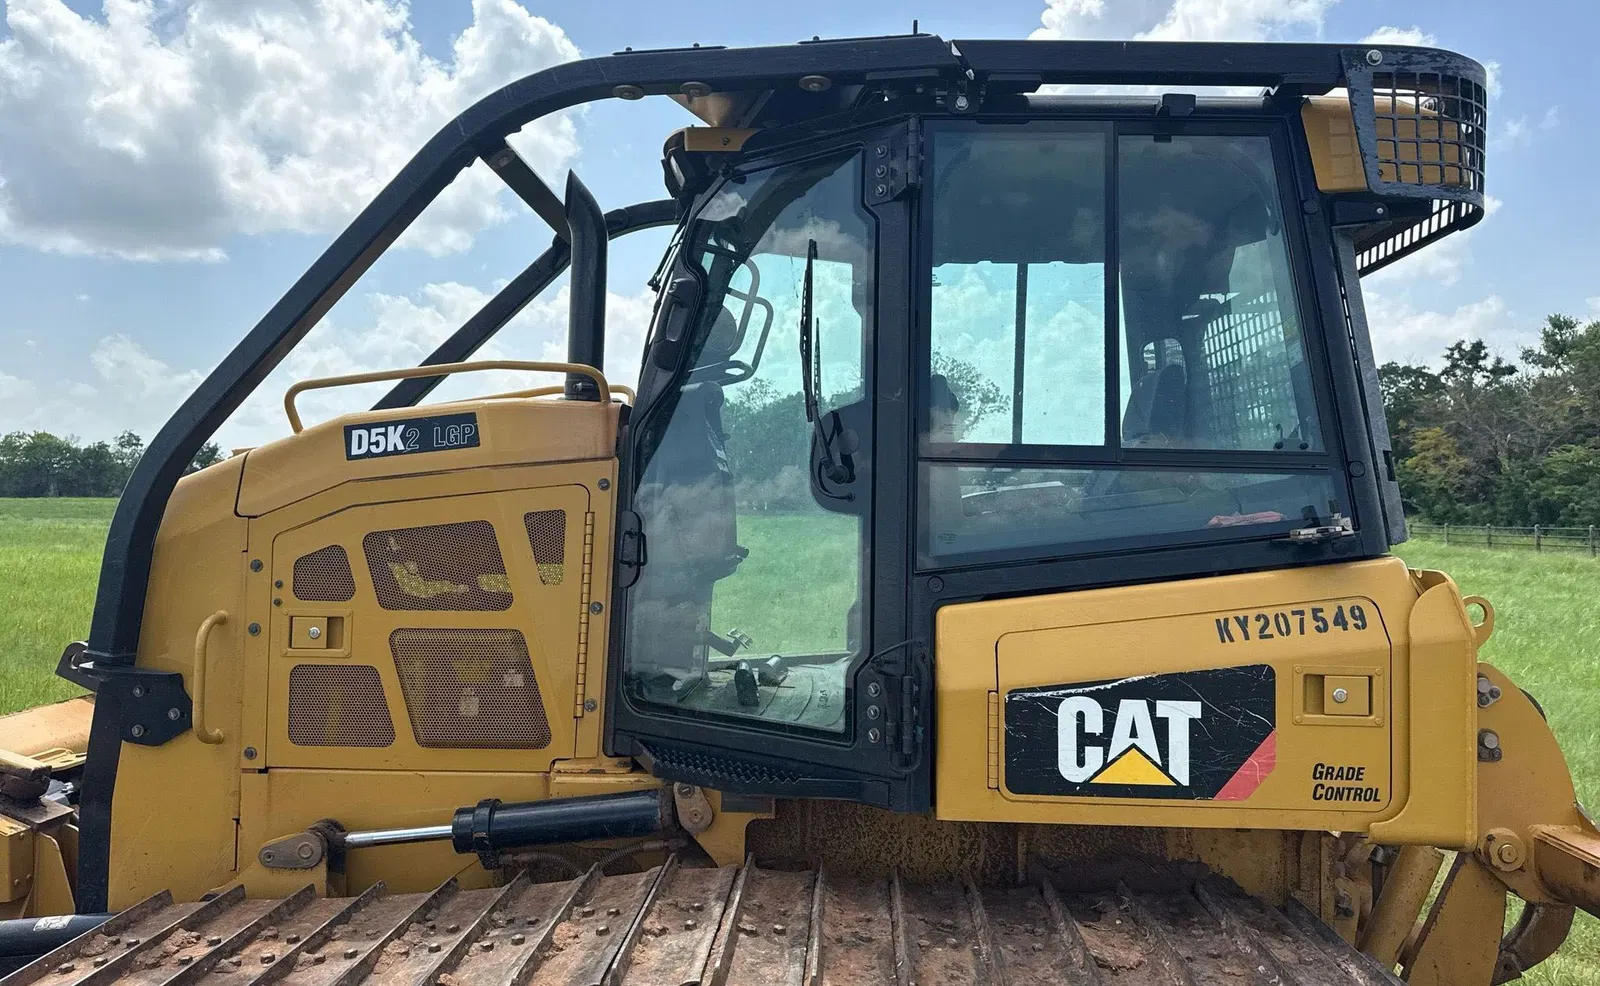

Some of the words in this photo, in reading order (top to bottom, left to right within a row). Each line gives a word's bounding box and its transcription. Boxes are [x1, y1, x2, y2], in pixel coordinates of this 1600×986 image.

[433, 423, 475, 448] LGP
[1215, 605, 1367, 644] KY207549
[1057, 695, 1202, 787] CAT
